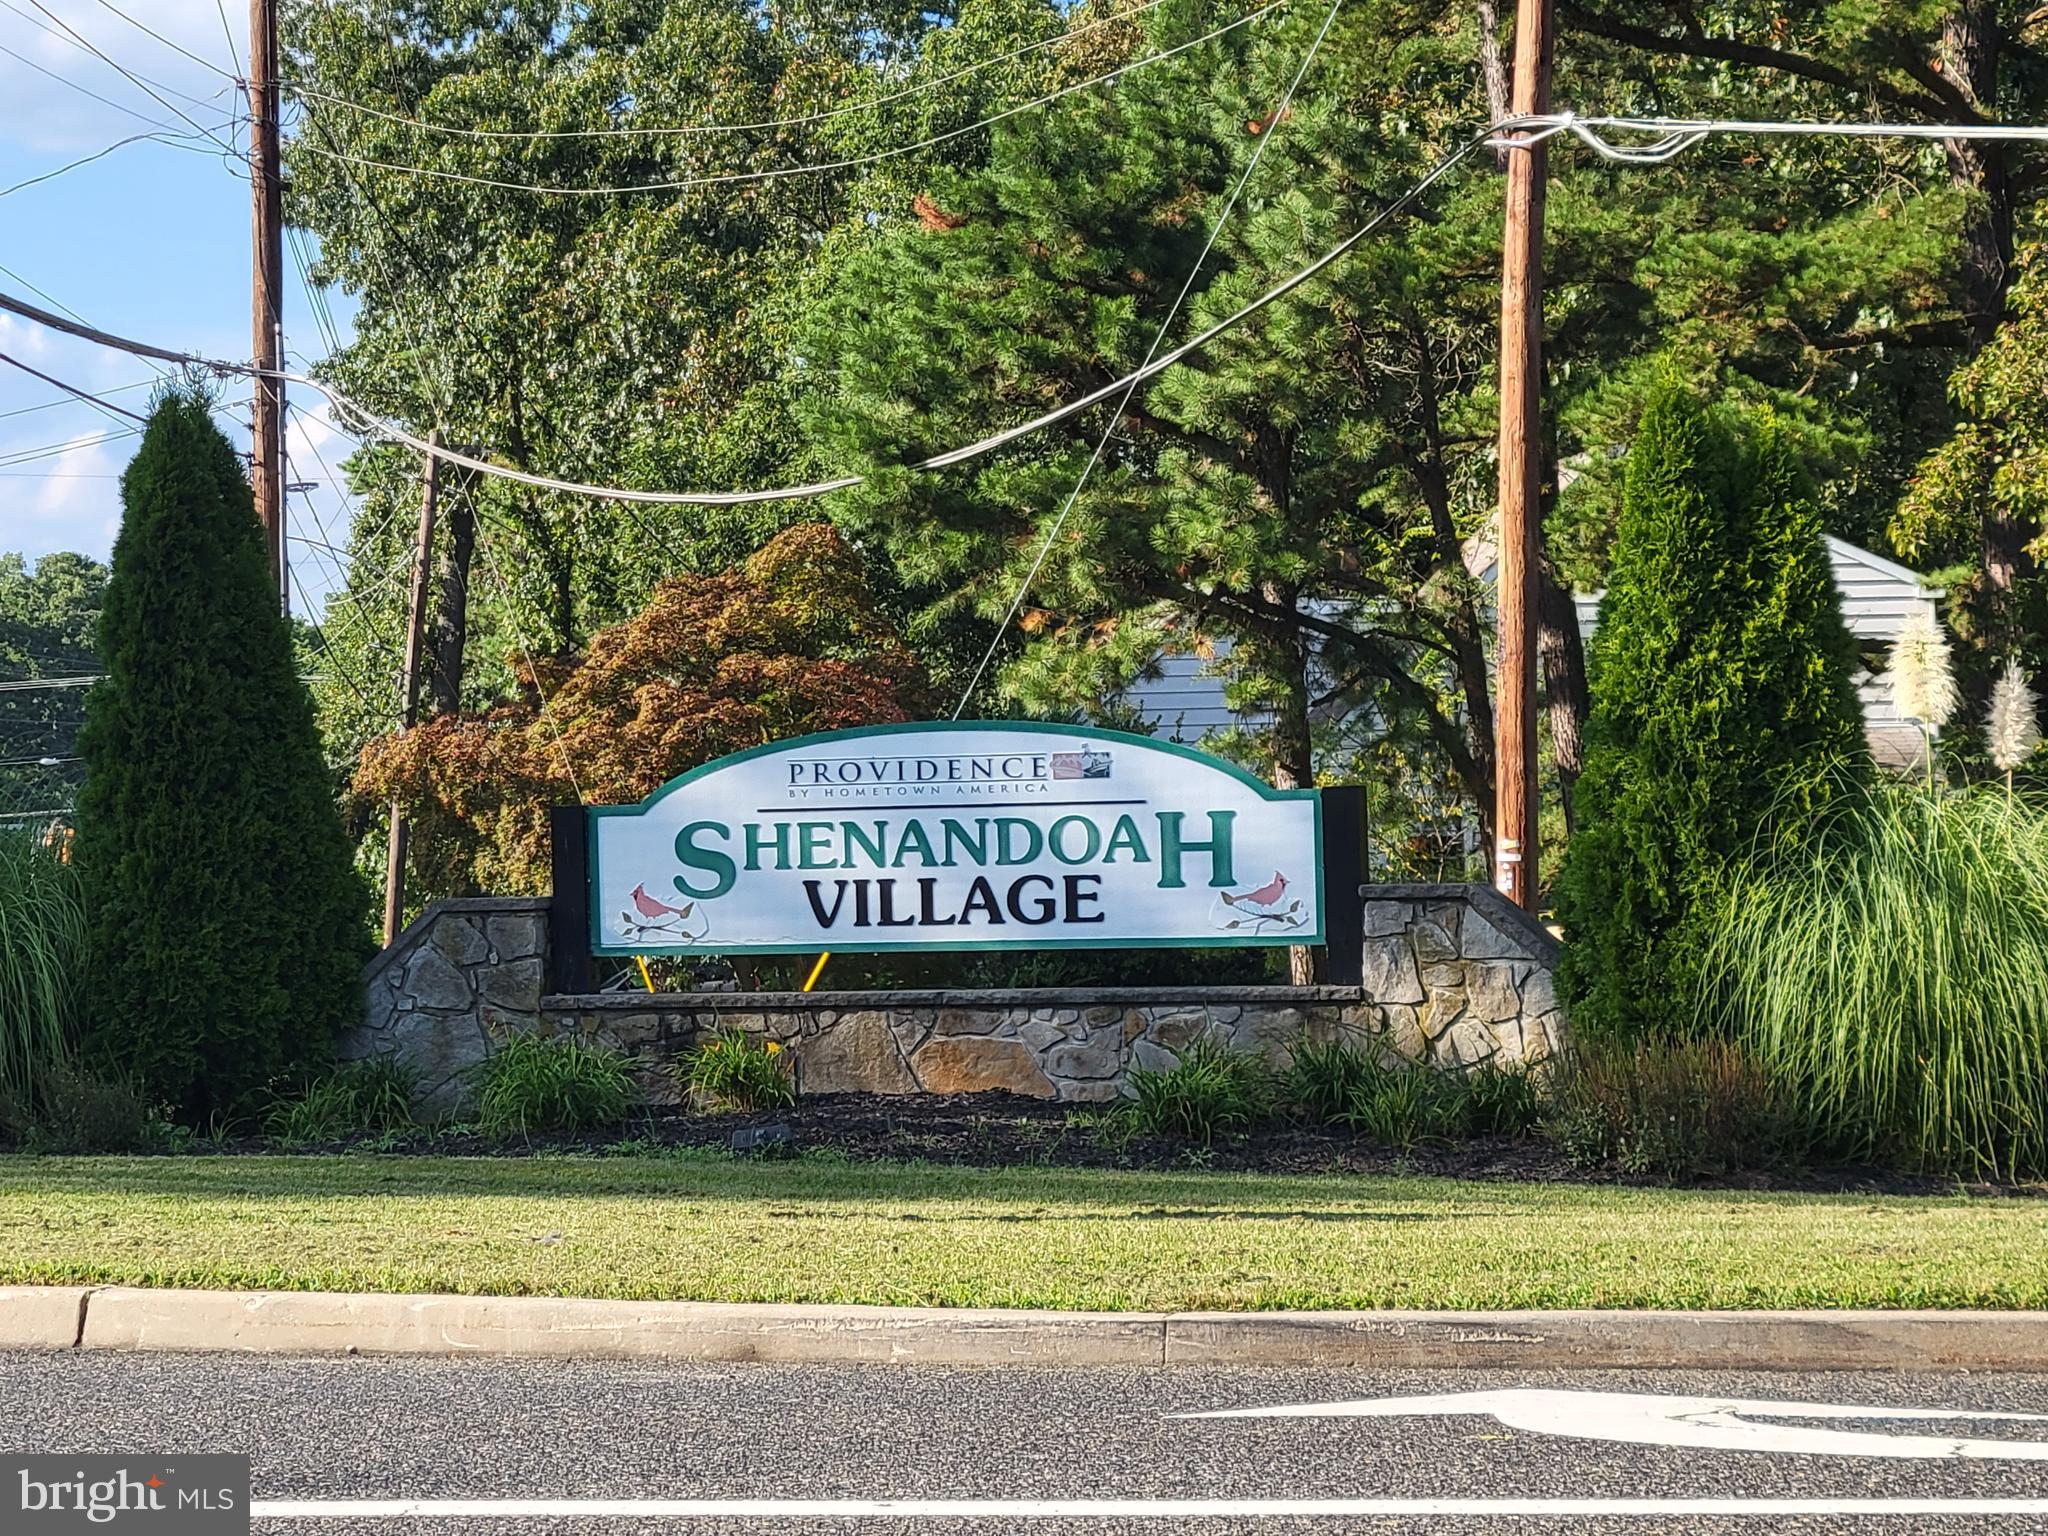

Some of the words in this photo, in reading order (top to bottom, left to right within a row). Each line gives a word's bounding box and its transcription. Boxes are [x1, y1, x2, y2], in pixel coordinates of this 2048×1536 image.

[788, 756, 1048, 784] PROVIDENCE
[788, 789, 809, 799] BY
[824, 786, 941, 797] HOMETOWN
[956, 783, 1049, 795] AMERICA
[672, 810, 1239, 900] SHENANDOAH
[802, 873, 1106, 929] VILLAGE
